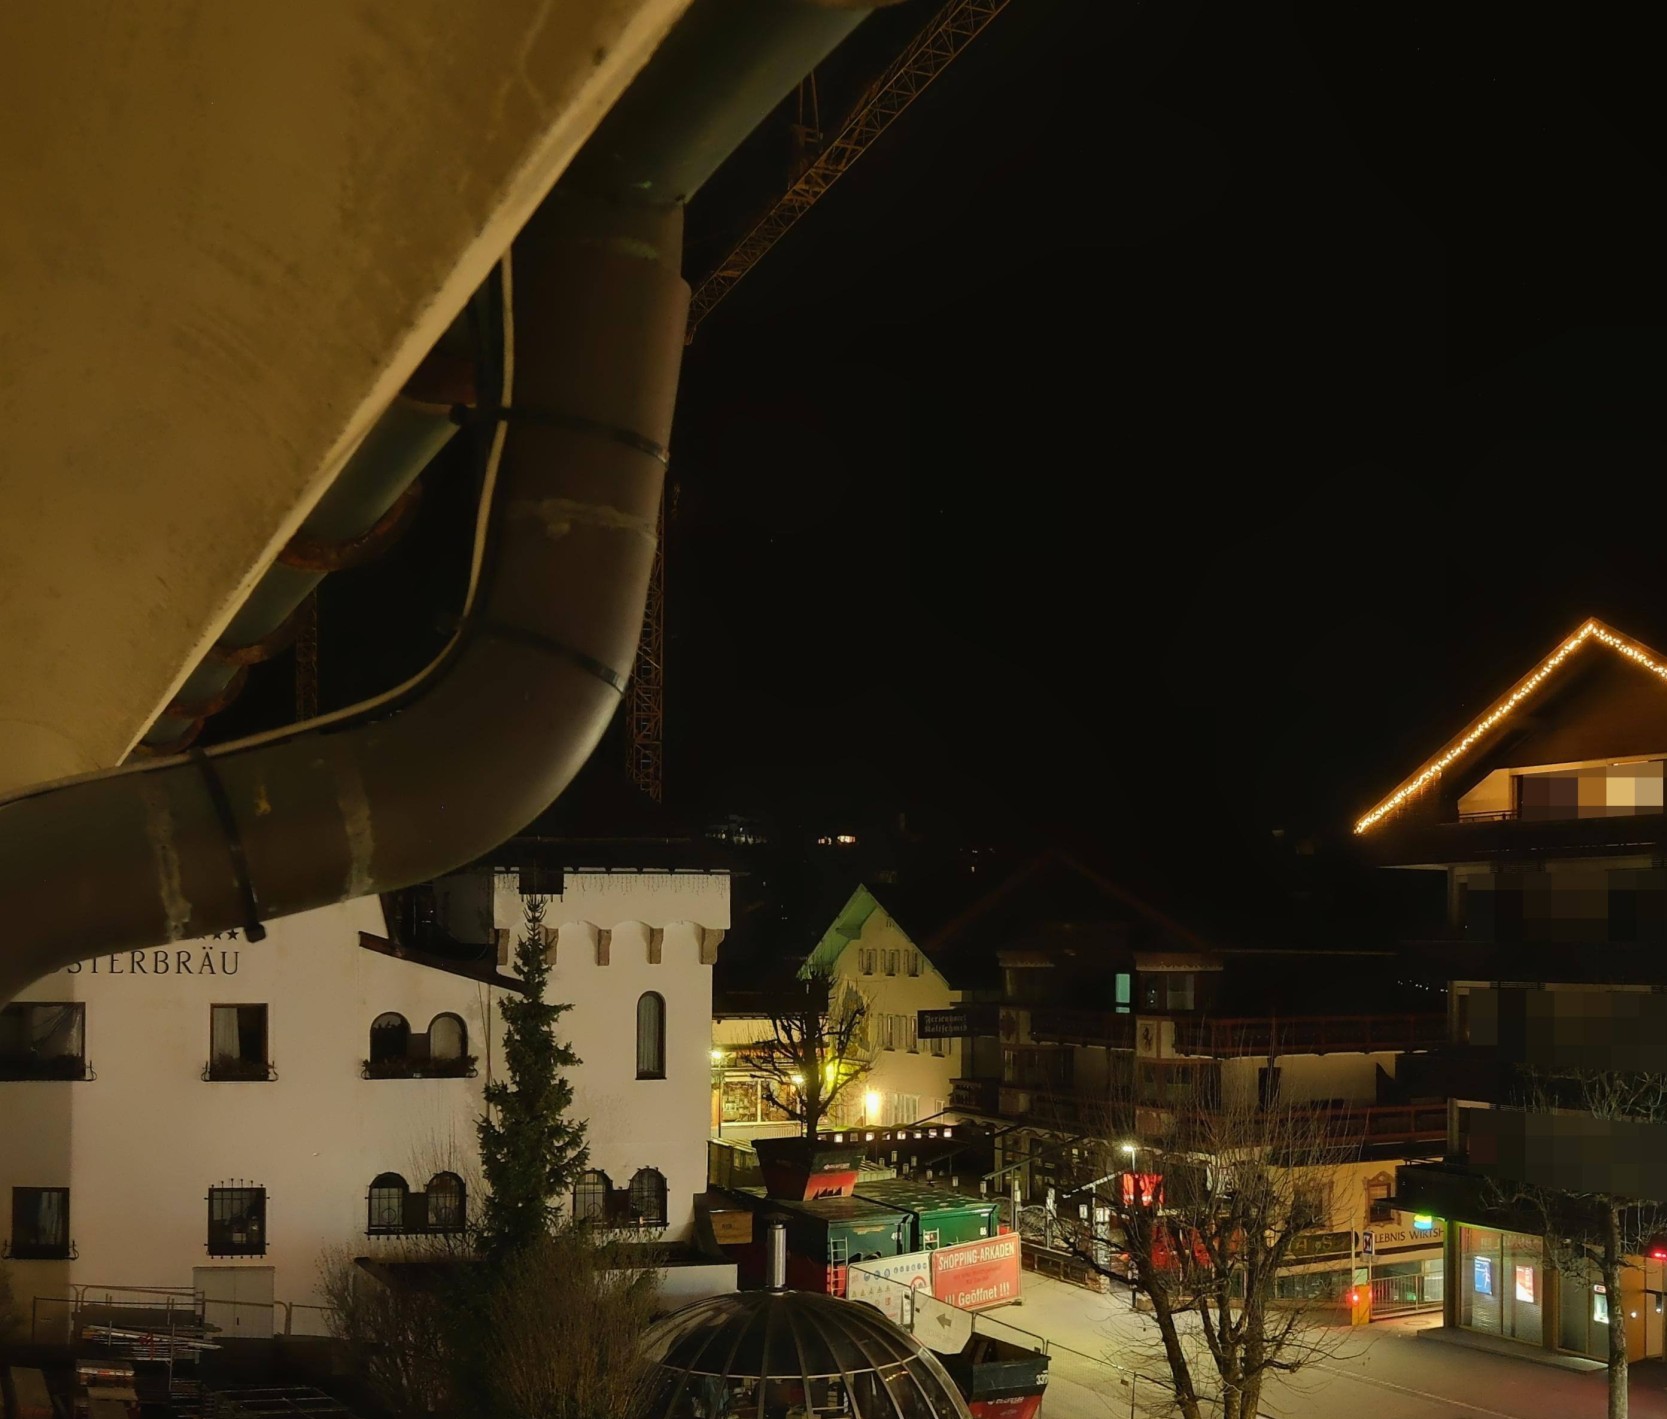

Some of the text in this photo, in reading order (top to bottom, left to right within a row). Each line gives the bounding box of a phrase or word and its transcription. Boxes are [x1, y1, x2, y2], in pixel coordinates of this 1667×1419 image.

[66, 946, 240, 975] STERBRÄU
[1374, 1232, 1406, 1244] LEBNIS
[938, 1242, 1015, 1270] SHOPPING-ARKADEN
[958, 1285, 998, 1306] Geöffnet
